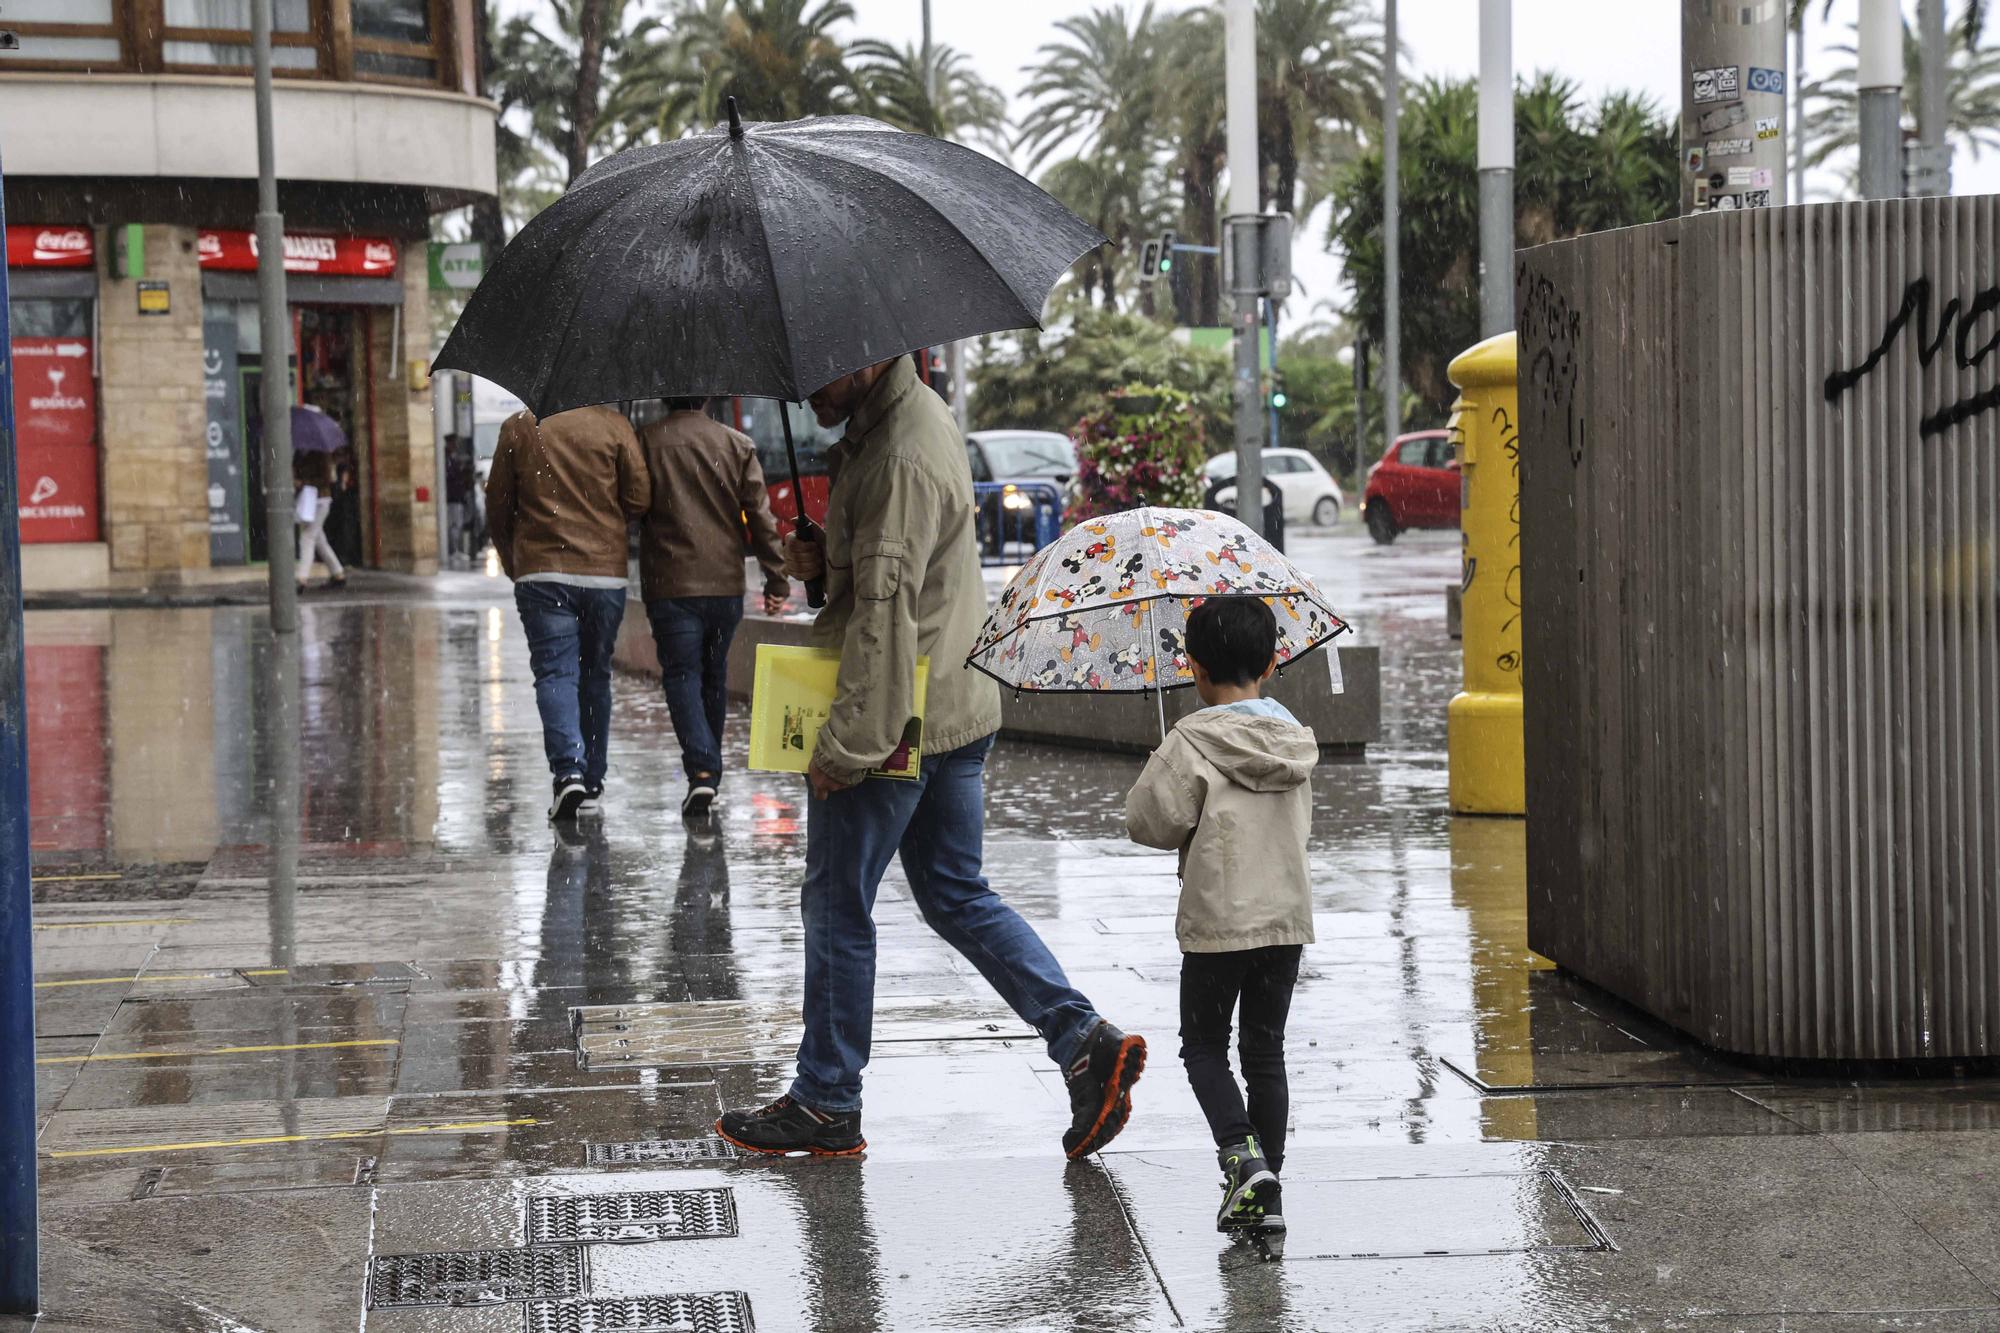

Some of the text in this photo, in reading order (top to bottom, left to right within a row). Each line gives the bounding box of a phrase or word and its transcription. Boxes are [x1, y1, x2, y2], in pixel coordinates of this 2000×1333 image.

[35, 230, 88, 250] Coca-Cola
[444, 259, 481, 271] ATM
[30, 396, 86, 410] BODEGA
